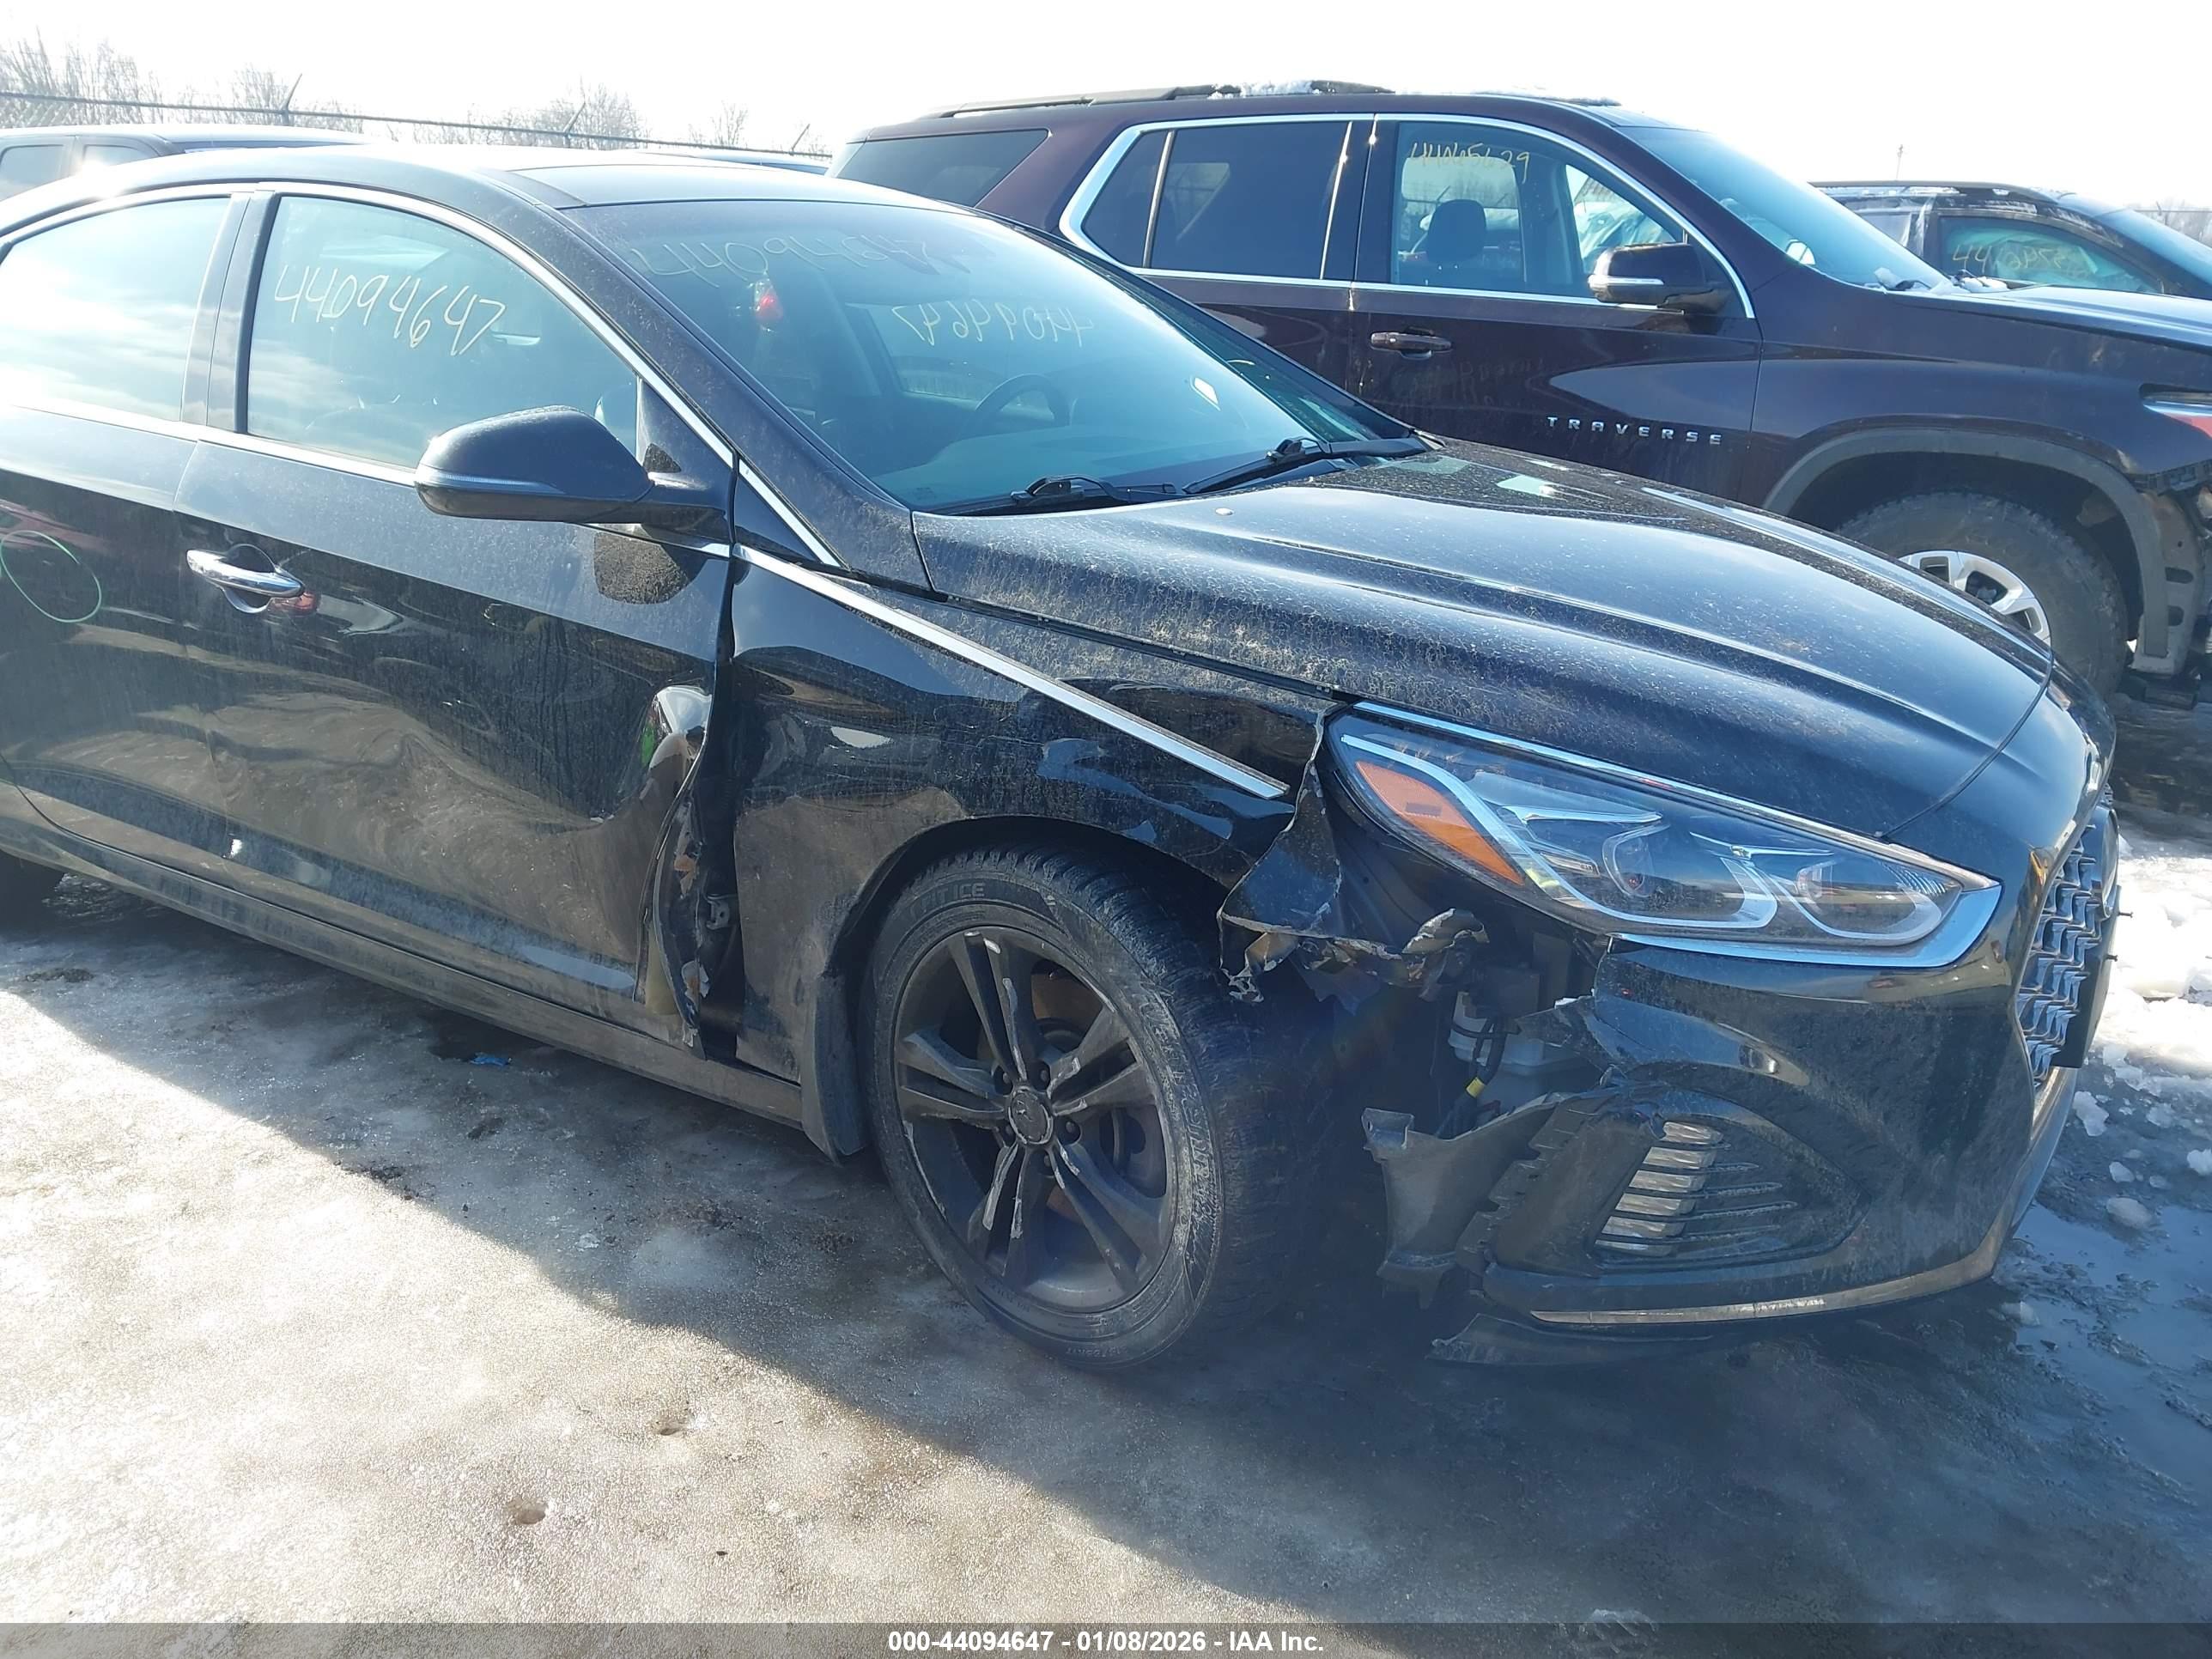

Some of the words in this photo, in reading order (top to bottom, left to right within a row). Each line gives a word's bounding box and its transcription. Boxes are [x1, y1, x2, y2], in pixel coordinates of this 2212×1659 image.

[273, 264, 507, 356] 44094647
[1546, 416, 1723, 445] TRAVERSE
[954, 882, 986, 899] ICE
